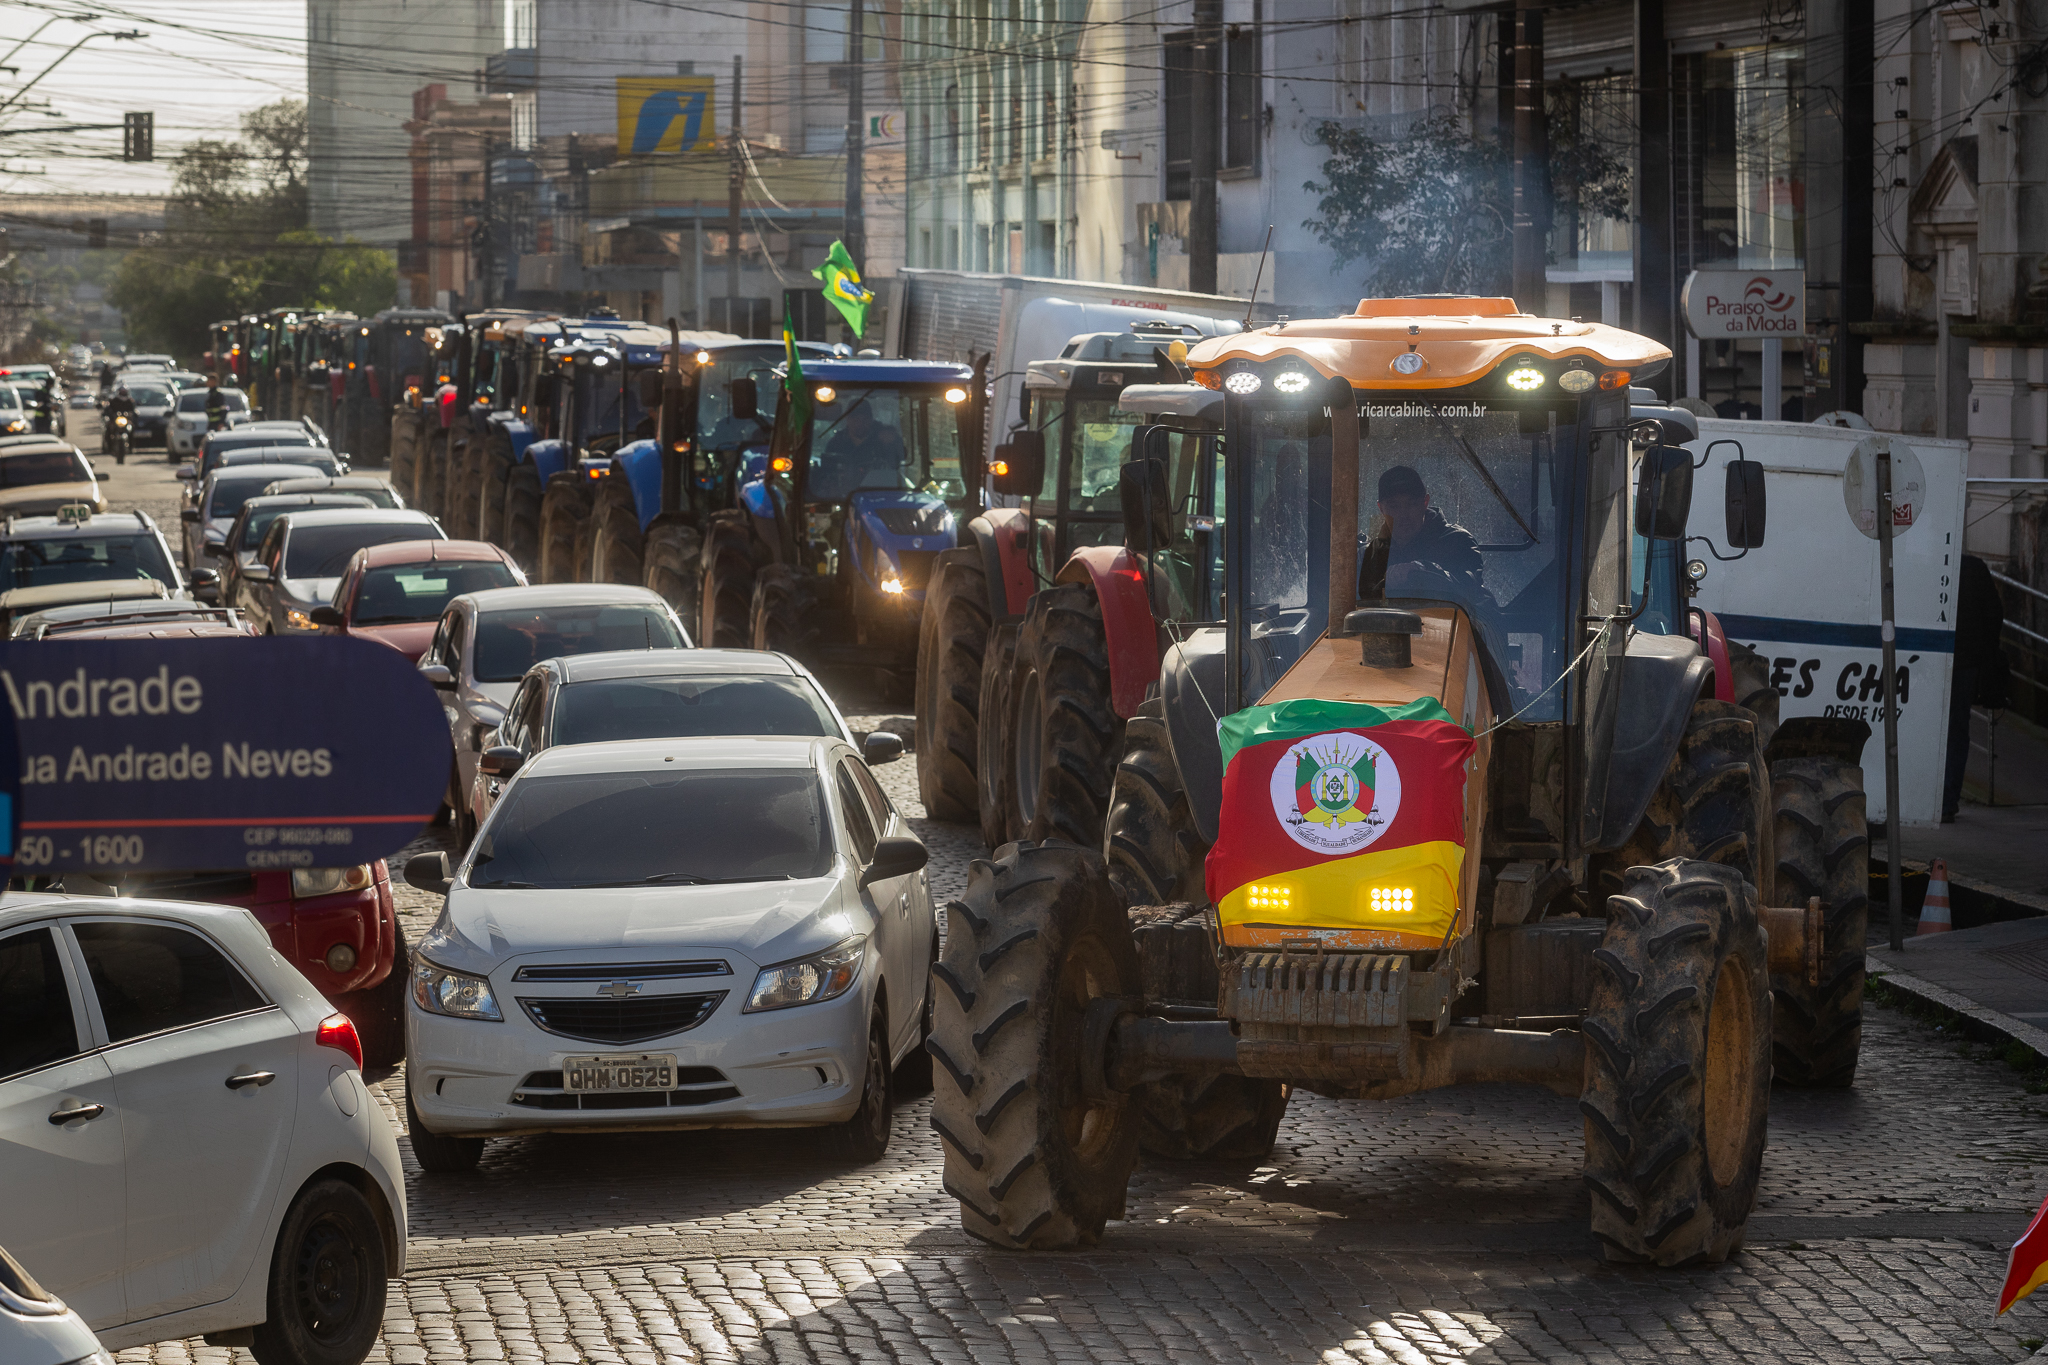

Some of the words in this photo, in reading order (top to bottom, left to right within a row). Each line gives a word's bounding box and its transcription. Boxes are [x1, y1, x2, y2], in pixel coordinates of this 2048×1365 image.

[1725, 318, 1743, 332] da
[1746, 314, 1797, 332] Moda
[1323, 401, 1487, 418] w.ricarcabine.com.br
[1823, 704, 1868, 722] DESDE
[1871, 707, 1904, 723] 197
[65, 744, 212, 783] Andrade
[222, 742, 332, 779] Neves
[243, 827, 278, 846] CEP
[80, 834, 144, 865] 1600
[245, 849, 314, 867] CENTRO
